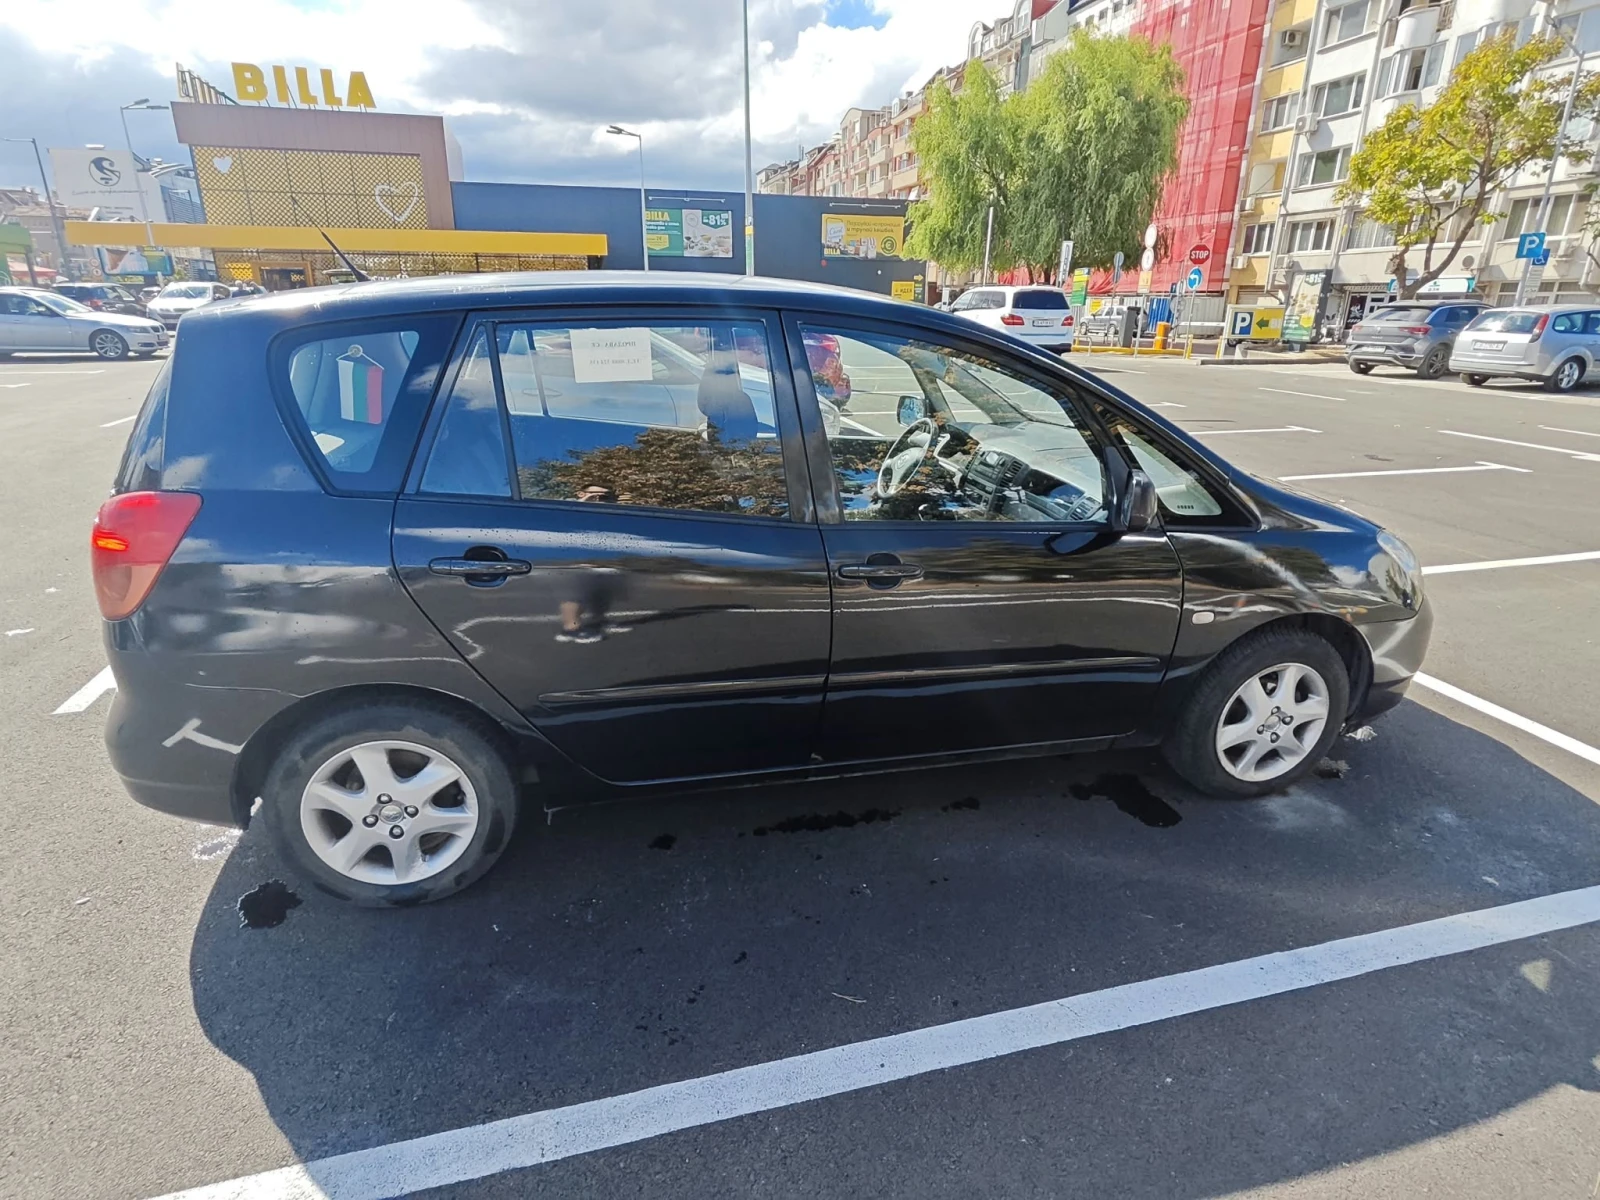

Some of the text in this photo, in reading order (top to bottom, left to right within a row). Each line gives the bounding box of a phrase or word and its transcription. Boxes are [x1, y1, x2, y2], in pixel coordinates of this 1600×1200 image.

[231, 62, 376, 108] BILLA
[645, 211, 670, 221] BILLA
[1190, 250, 1209, 260] STOP
[1523, 235, 1540, 256] P
[1235, 312, 1251, 335] P
